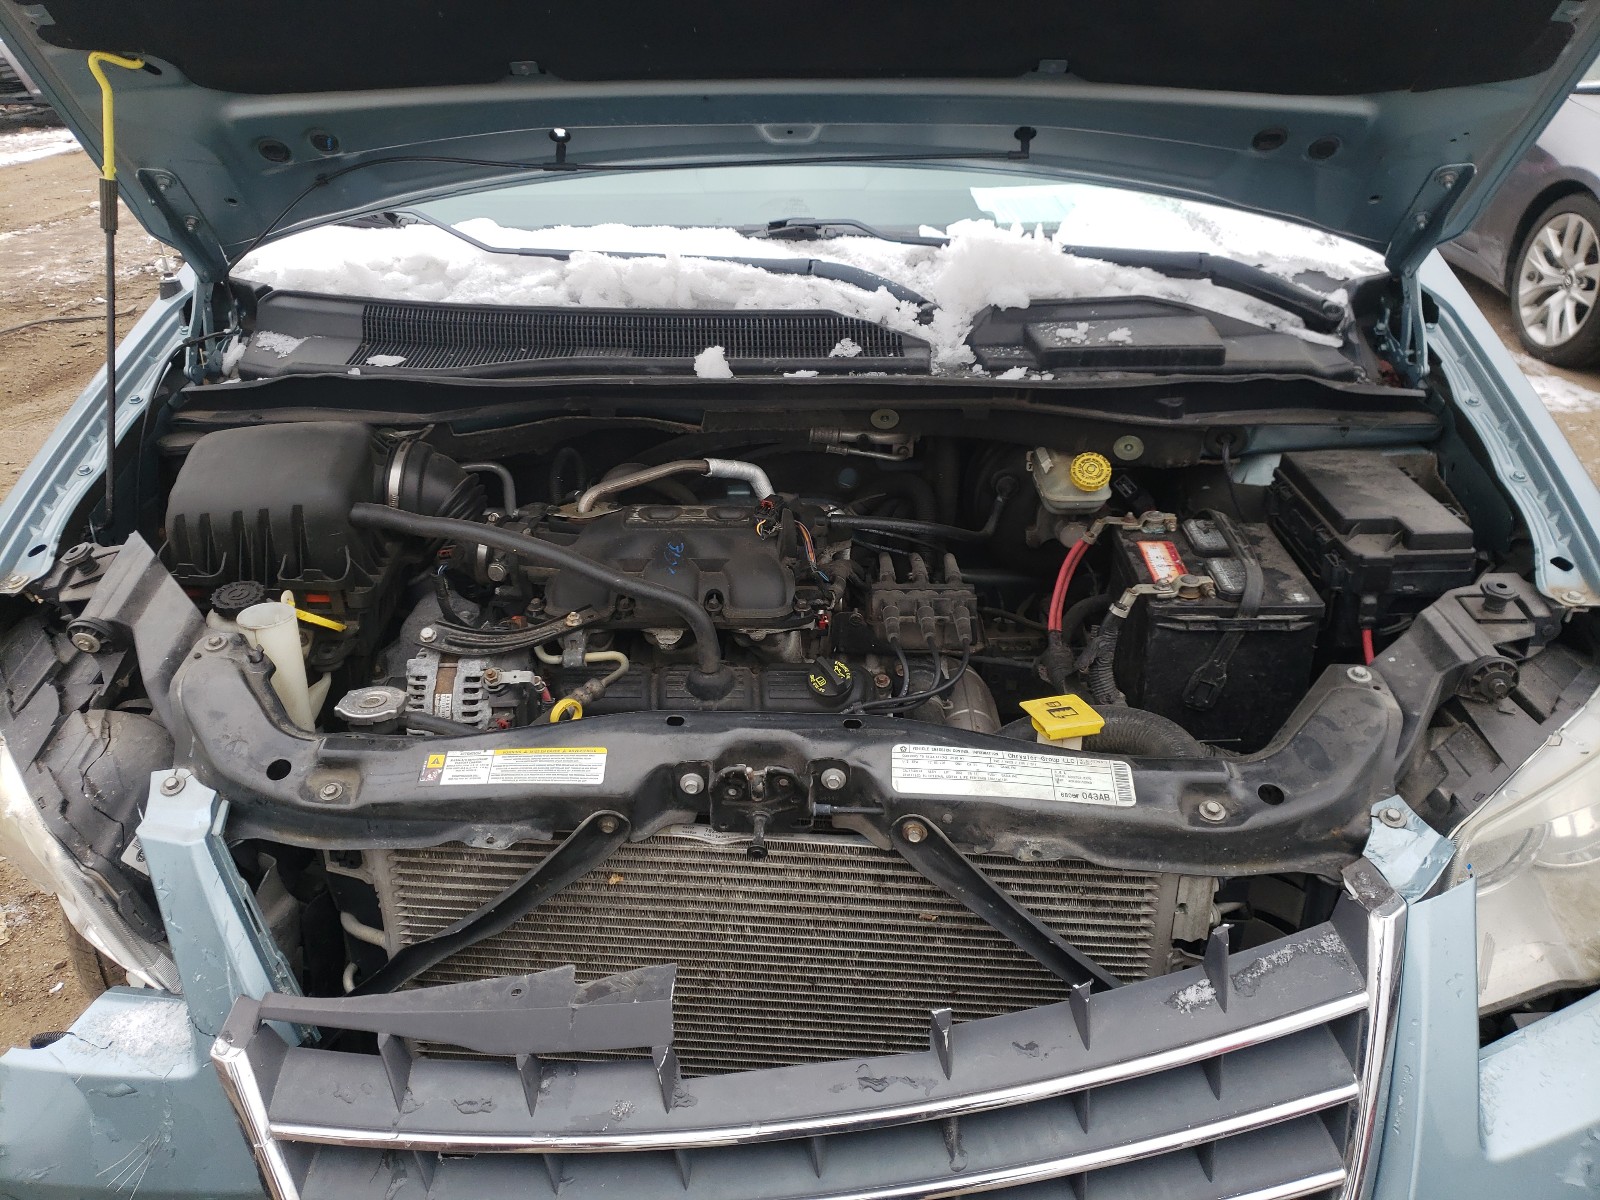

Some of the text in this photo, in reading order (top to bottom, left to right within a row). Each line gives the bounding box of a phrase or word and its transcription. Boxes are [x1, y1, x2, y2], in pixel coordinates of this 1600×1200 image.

[1007, 752, 1037, 761] Chrysler
[1040, 755, 1060, 764] Group
[1062, 757, 1075, 765] LLC
[1081, 792, 1111, 802] 043AB
